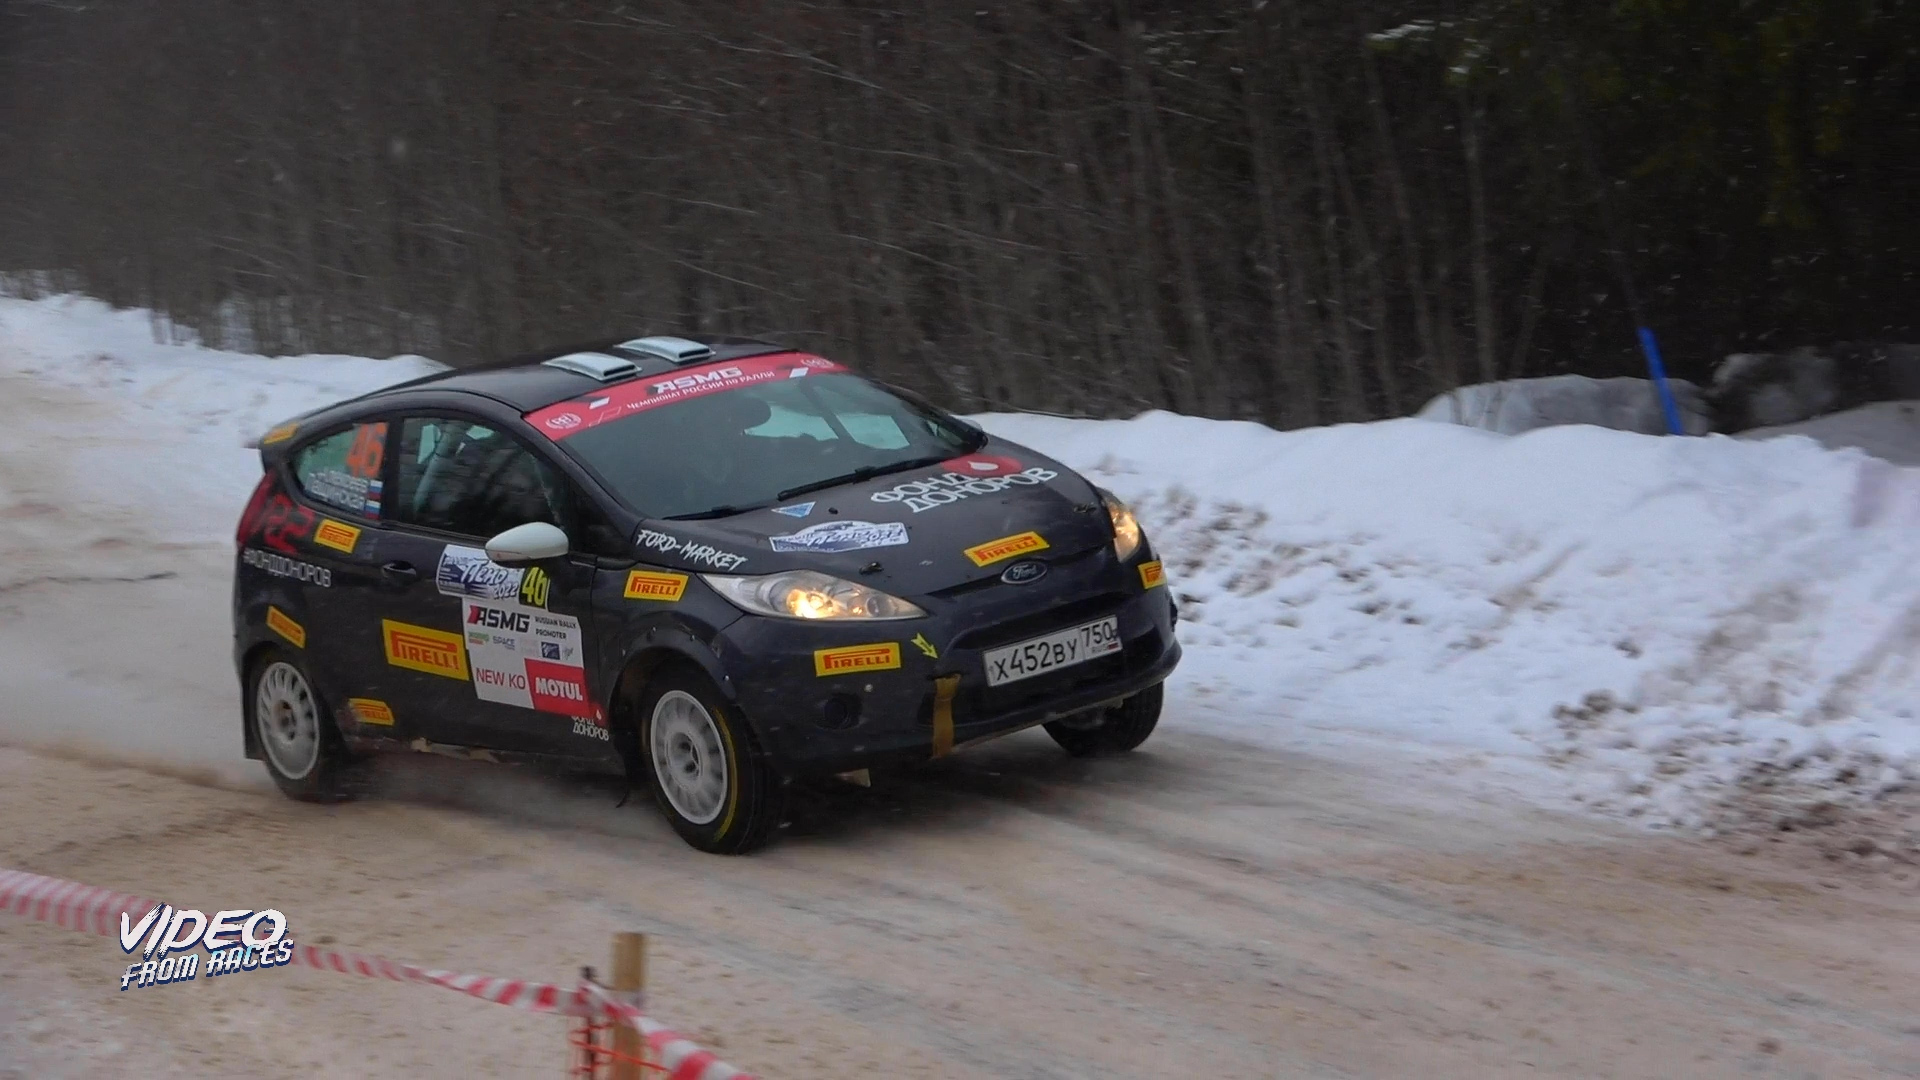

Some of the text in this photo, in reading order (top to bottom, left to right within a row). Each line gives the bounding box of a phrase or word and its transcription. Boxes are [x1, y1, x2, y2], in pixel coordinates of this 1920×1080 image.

[652, 366, 743, 395] ASMG
[682, 380, 725, 396] РОССИИ
[739, 371, 776, 385] РАЛЛИ
[346, 422, 388, 478] 46
[870, 471, 981, 503] ФОНД
[903, 467, 1058, 513] ДОНОРОВ
[636, 529, 749, 572] FORD-MARKET
[1012, 564, 1038, 580] Ford
[493, 581, 519, 600] 2022
[521, 566, 548, 606] 46
[630, 576, 682, 597] PIRELLI
[467, 604, 531, 634] ASMG
[535, 628, 568, 640] PROMOTER
[1081, 621, 1114, 647] 750
[390, 629, 460, 670] PIRELLI
[823, 647, 891, 670] PIRELLI
[476, 667, 526, 690] NEW KO
[535, 677, 584, 701] MOTUL
[572, 721, 610, 741] ДОНОРОВ
